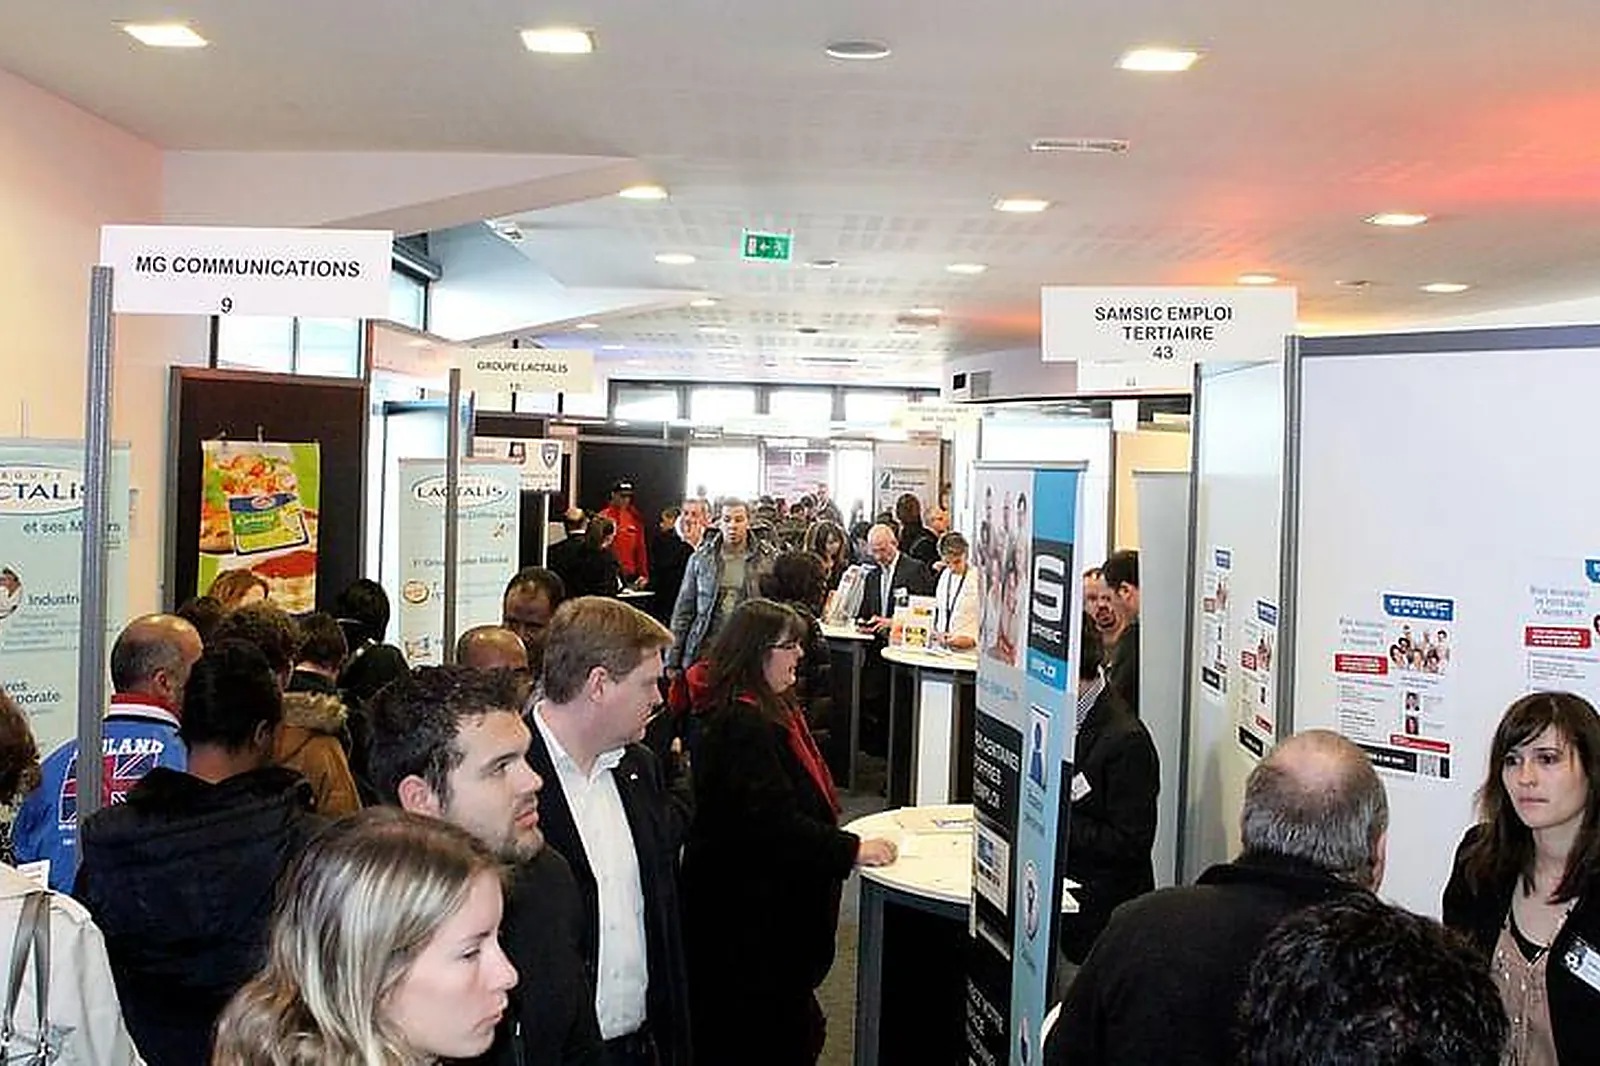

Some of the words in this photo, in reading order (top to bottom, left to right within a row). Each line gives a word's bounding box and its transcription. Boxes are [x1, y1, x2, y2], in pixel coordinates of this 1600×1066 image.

[135, 256, 167, 273] MG
[172, 257, 361, 278] COMMUNICATIONS
[220, 297, 233, 314] 9
[1094, 306, 1163, 321] SAMSIC
[1167, 306, 1232, 321] EMPLOI
[1122, 326, 1214, 341] TERTIAIRE
[1152, 346, 1174, 360] 43
[477, 361, 519, 371] GROUPE
[521, 362, 568, 374] LACTALIS
